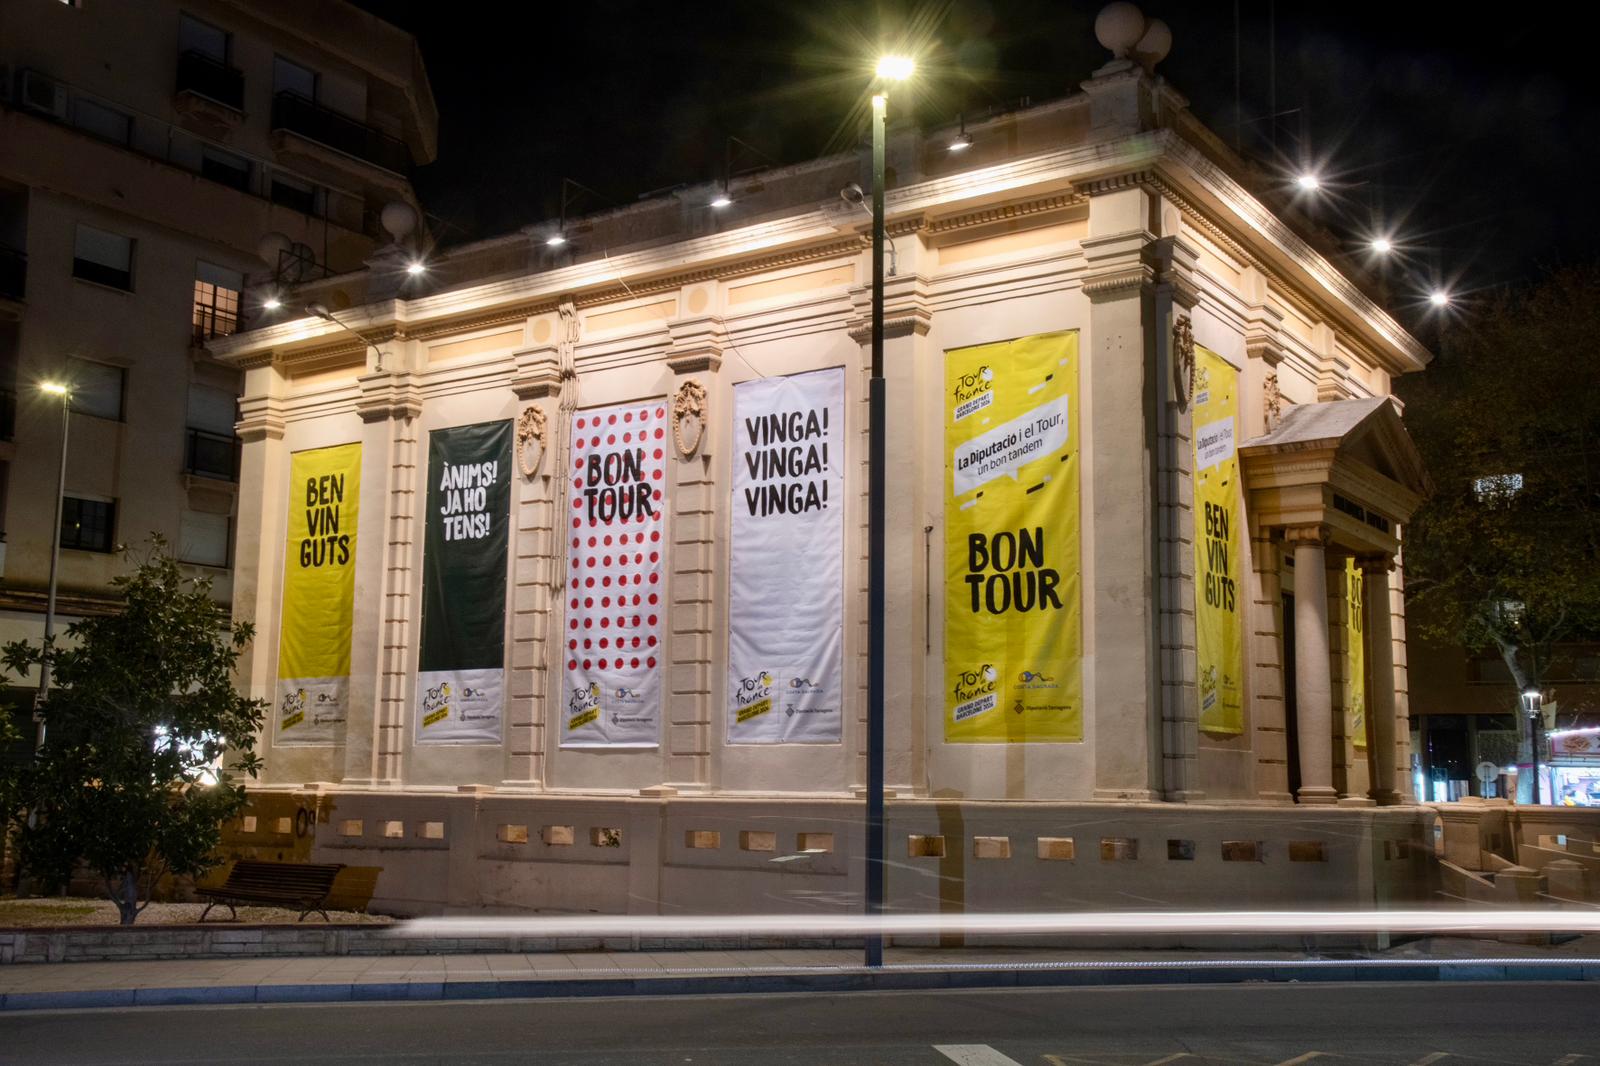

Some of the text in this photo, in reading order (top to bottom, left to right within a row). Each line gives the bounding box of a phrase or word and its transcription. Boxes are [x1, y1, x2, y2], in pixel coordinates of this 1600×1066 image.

[745, 407, 829, 446] VINGA!
[958, 413, 1064, 471] La Diputació i el Tour,
[440, 460, 498, 492] ÀNIMS!
[587, 447, 642, 487] BON
[744, 442, 828, 481] VINGA!
[977, 438, 1043, 475] un bon tandem
[306, 473, 344, 507] BEN
[440, 486, 487, 515] JA HO
[583, 482, 654, 523] TOUR
[744, 479, 828, 518] VINGA!
[306, 505, 340, 537] VIN
[443, 512, 491, 541] TENS!
[1205, 501, 1229, 542] BEN
[300, 534, 350, 568] GUTS
[968, 526, 1044, 573] BON
[1206, 537, 1228, 576] VIN
[965, 568, 1064, 615] TOUR
[1205, 571, 1235, 613] GUTS
[1351, 574, 1362, 606] BO
